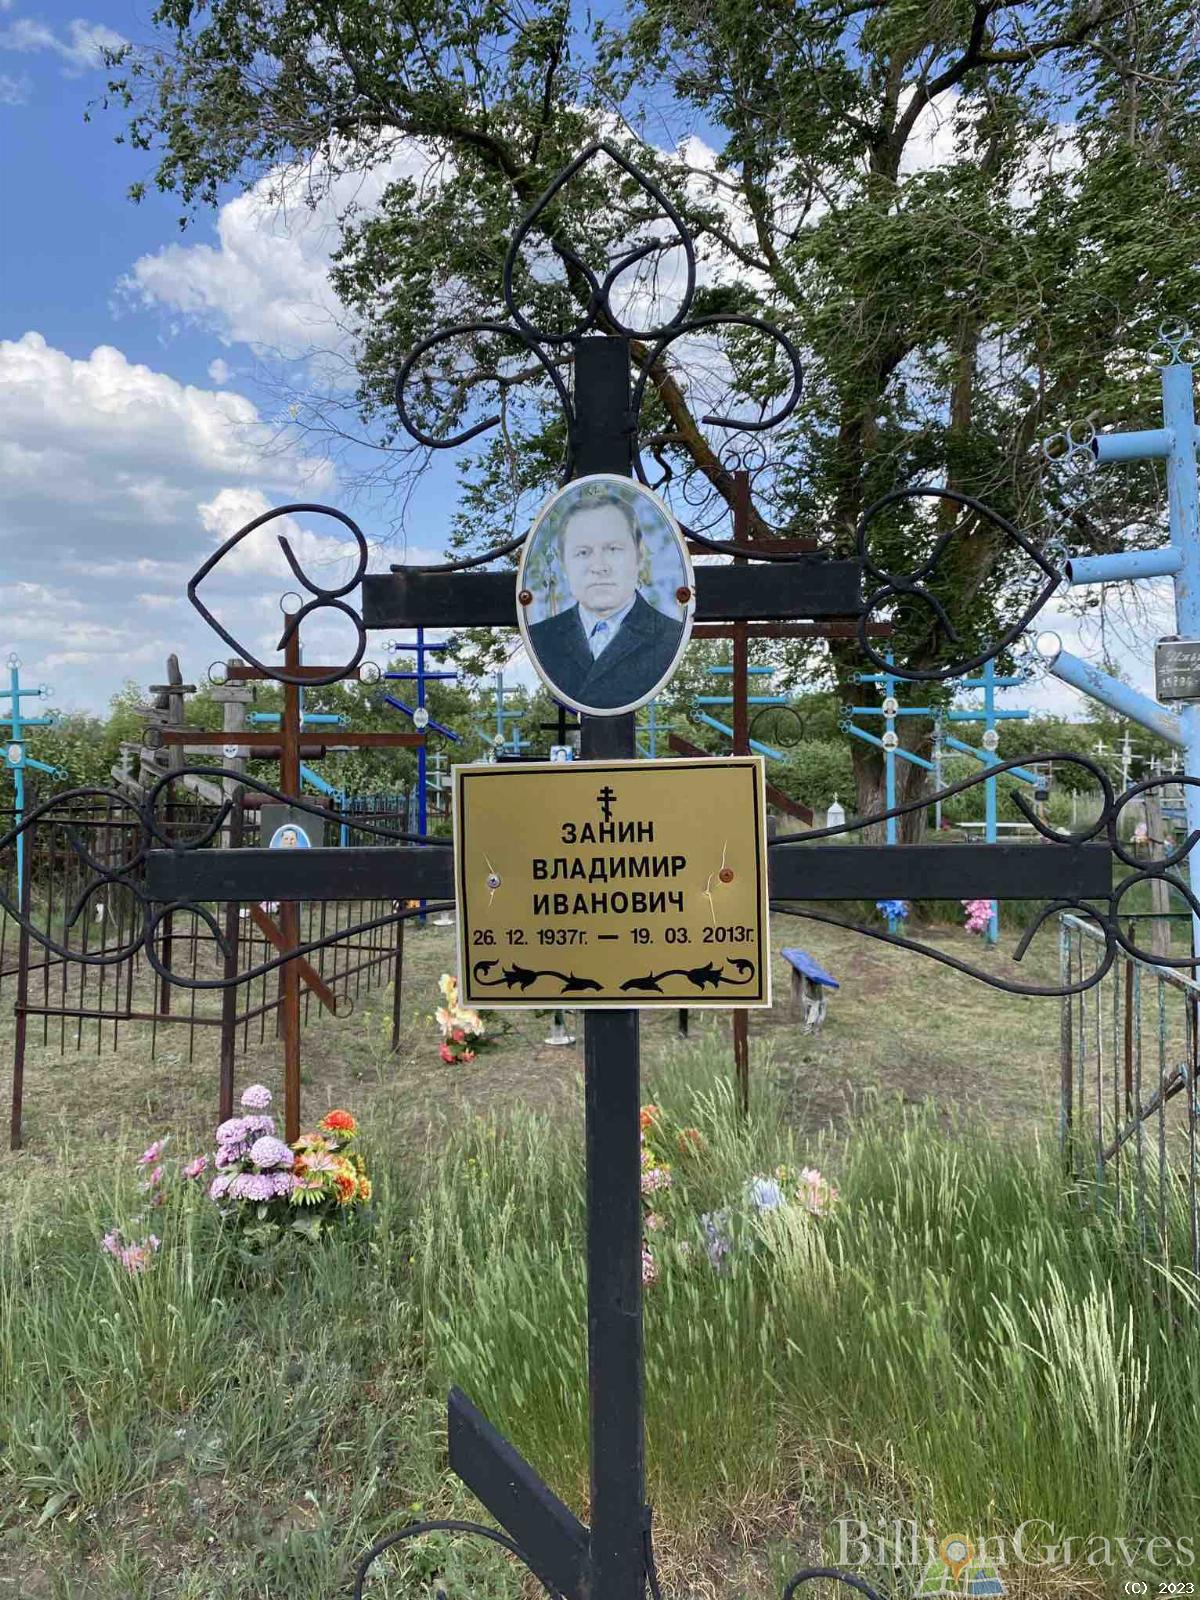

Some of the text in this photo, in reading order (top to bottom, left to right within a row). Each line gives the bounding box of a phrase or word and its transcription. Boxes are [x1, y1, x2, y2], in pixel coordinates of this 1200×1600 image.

[561, 821, 654, 844] ЗАНИН
[532, 855, 687, 883] ВЛАДИМИР
[533, 890, 684, 915] ИВАНОВИЧ
[473, 929, 497, 945] 26.
[505, 929, 529, 945] 12.
[536, 928, 588, 946] 1937г.
[630, 927, 654, 944] 19.
[664, 927, 692, 944] 03.
[702, 926, 755, 943] 2013г.
